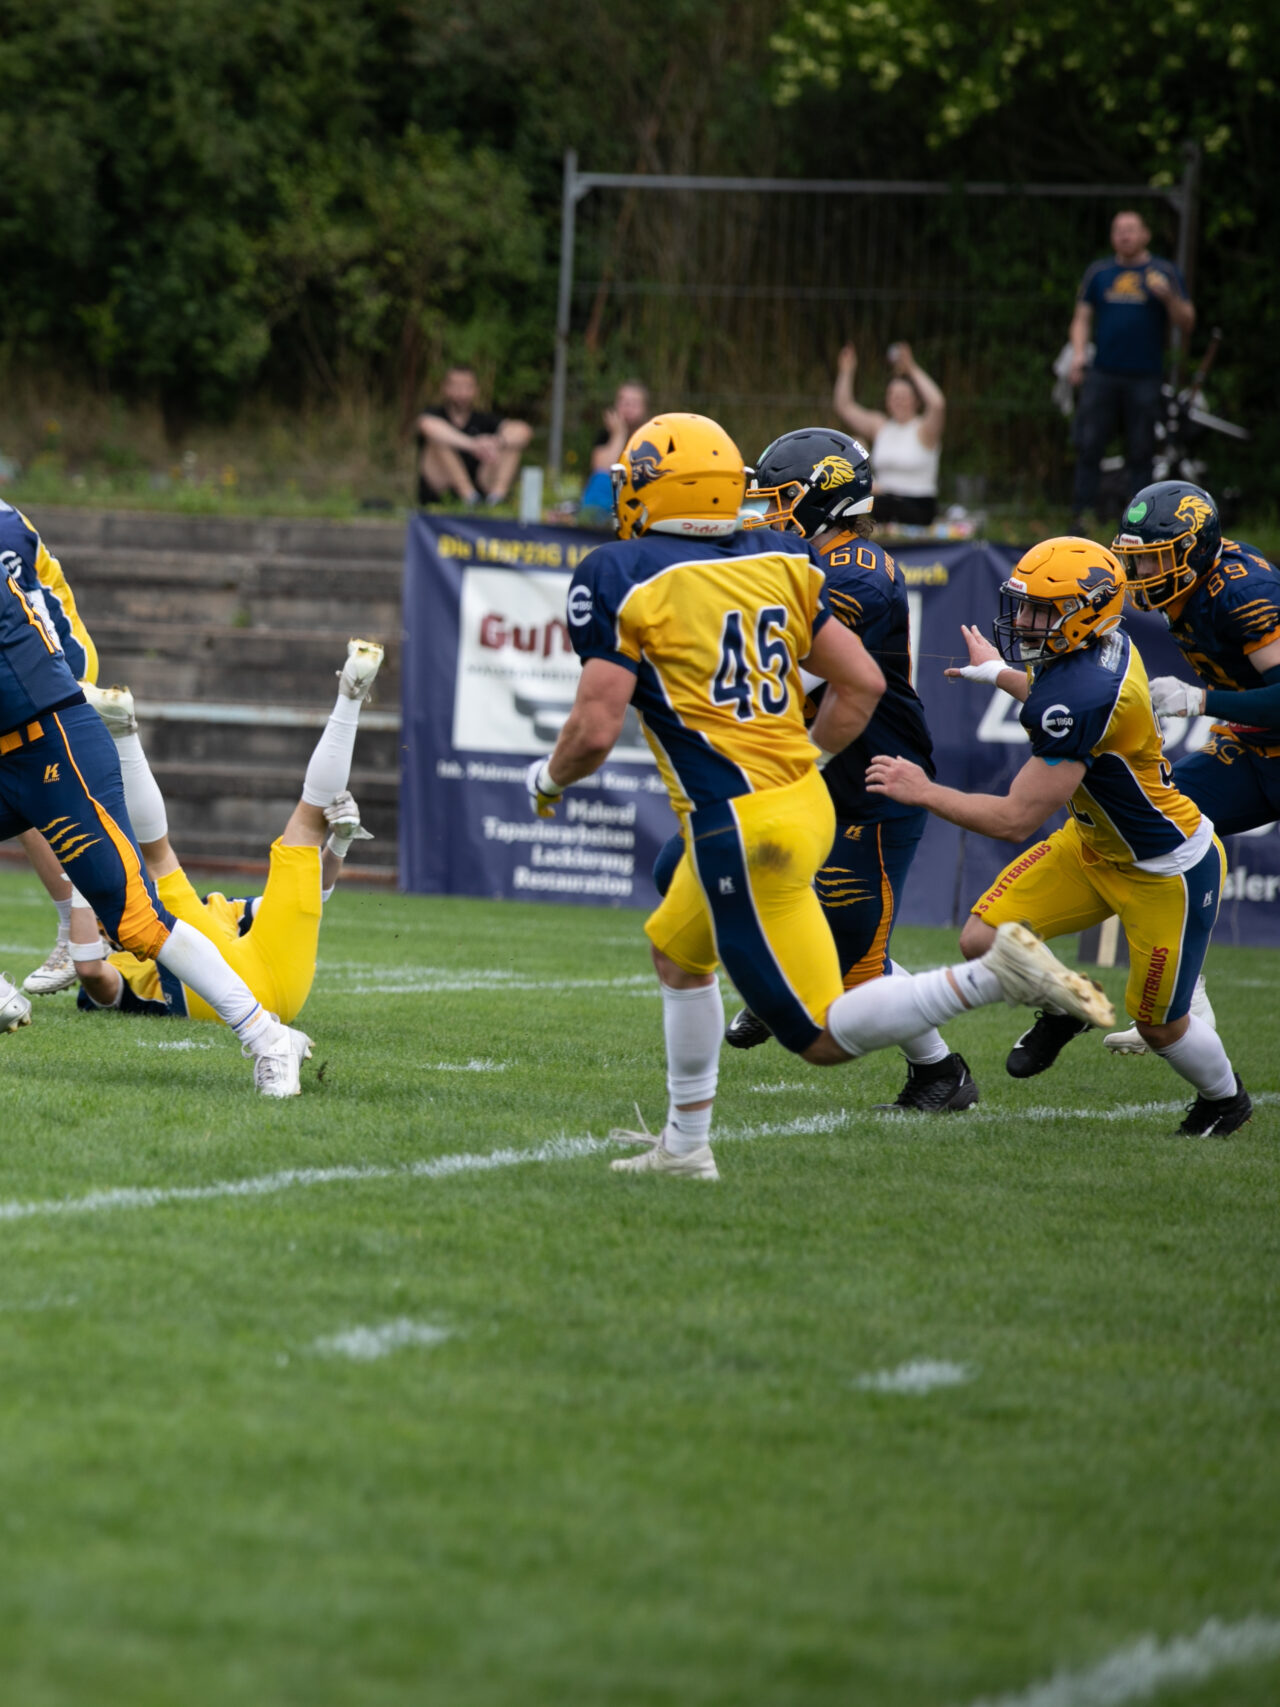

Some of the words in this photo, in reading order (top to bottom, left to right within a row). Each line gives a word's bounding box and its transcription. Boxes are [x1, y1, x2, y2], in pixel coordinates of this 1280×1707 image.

[829, 547, 877, 571] 60
[1206, 562, 1250, 599] 89
[710, 605, 791, 723] 45
[985, 842, 1053, 904] FUTTERHAUS
[1144, 945, 1169, 1015] FUTTERHAUS
